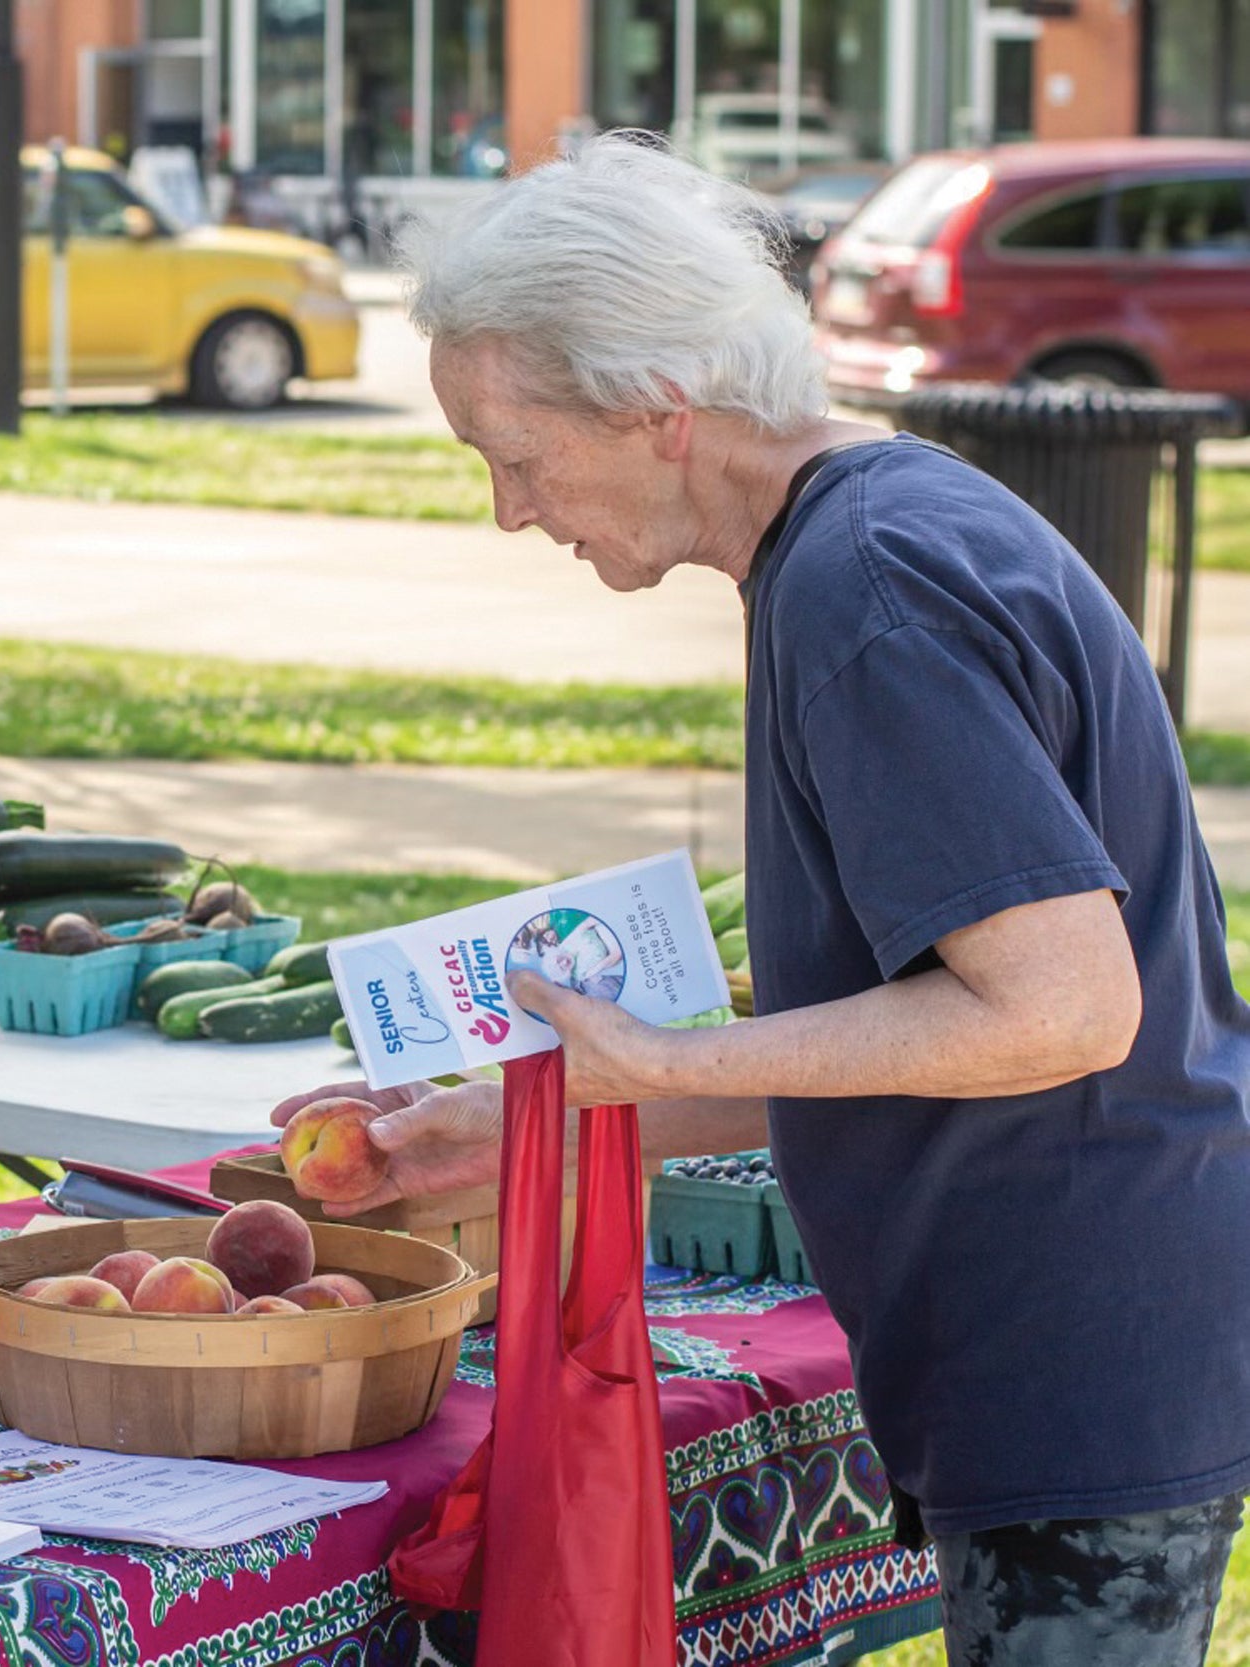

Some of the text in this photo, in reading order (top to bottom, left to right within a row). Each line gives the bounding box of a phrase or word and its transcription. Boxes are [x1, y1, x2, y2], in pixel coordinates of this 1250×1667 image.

[440, 944, 473, 1013] GECAC
[457, 939, 478, 993] community
[471, 937, 509, 1019] Action
[626, 914, 658, 989] Come see
[631, 884, 678, 1005] what the fuss is
[651, 906, 684, 978] all about!
[367, 979, 404, 1054] SENIOR
[400, 970, 450, 1044] Centers
